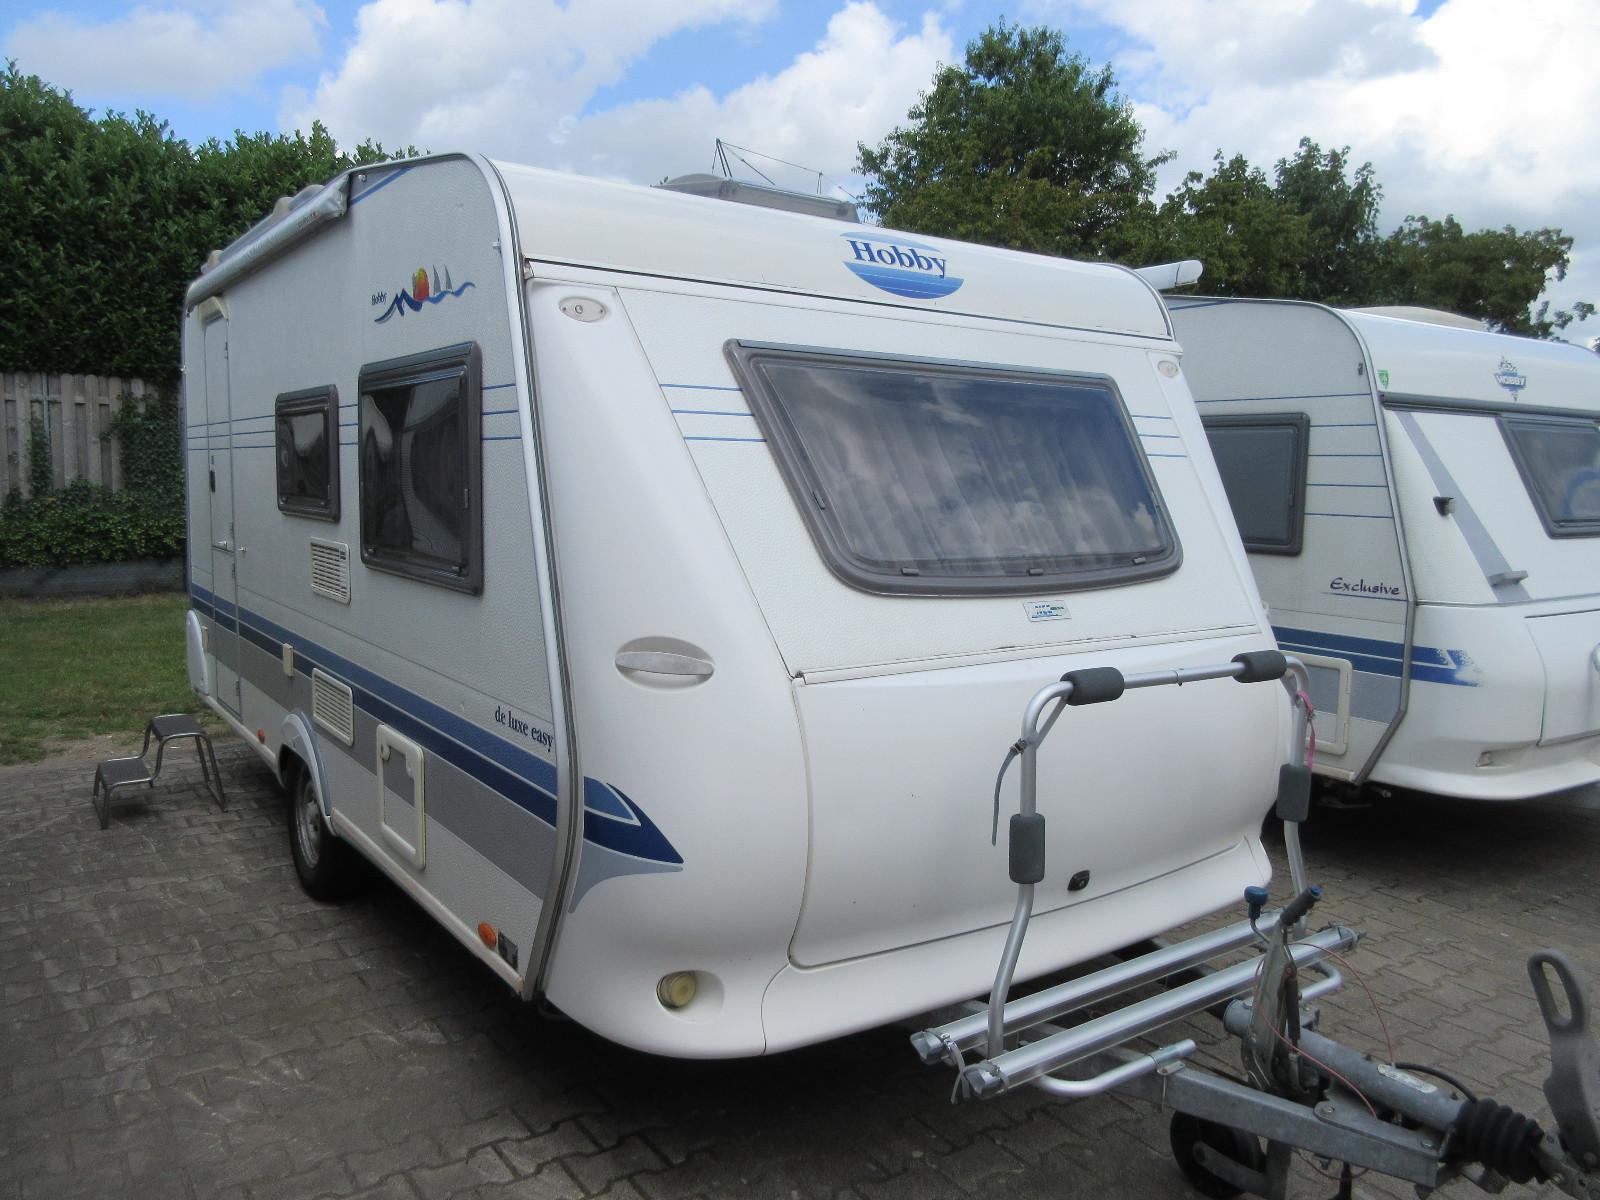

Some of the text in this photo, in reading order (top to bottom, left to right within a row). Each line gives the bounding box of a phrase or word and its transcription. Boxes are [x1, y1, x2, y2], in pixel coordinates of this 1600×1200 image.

[846, 239, 947, 279] Hobby
[1330, 577, 1400, 595] Exclusive
[495, 705, 554, 752] de luxe easy
